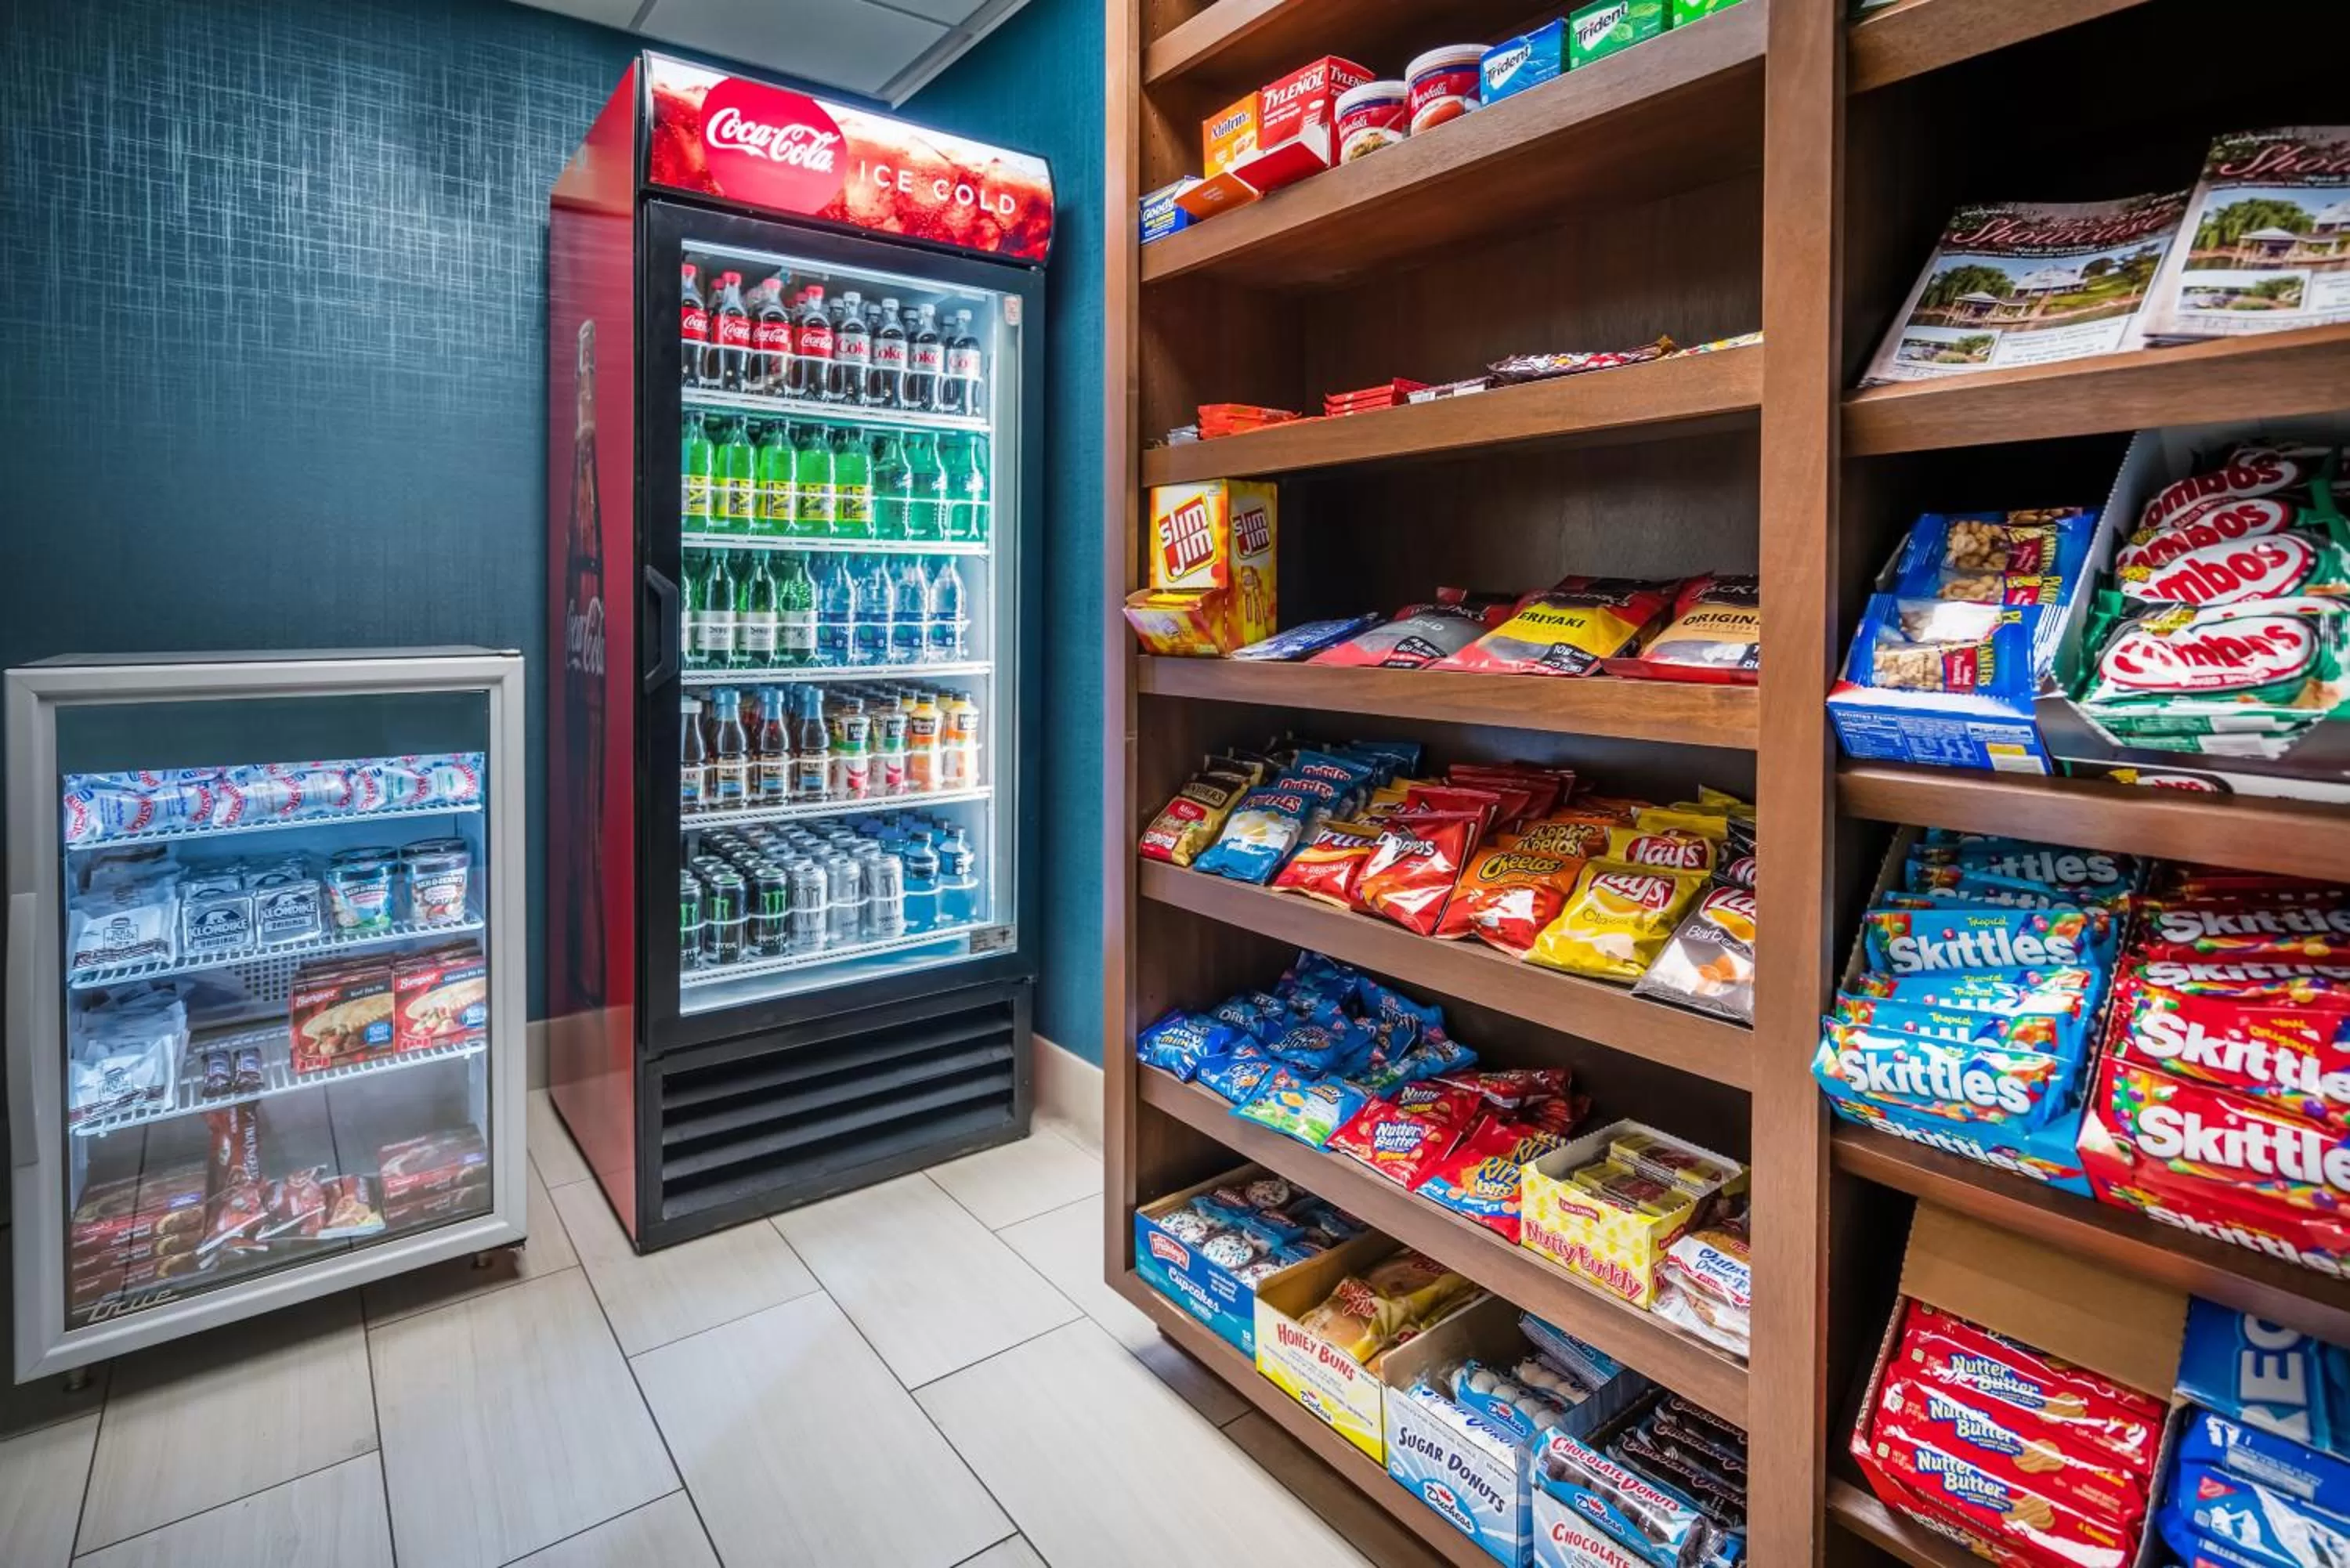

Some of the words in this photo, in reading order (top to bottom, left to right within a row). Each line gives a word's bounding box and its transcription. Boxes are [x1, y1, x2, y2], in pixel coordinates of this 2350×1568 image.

[1575, 0, 1627, 45] Trident
[1330, 66, 1366, 87] TYLEN
[1486, 45, 1530, 84] Trident
[1264, 69, 1325, 114] TYLENOL
[707, 107, 840, 173] Coca-Cola
[860, 161, 913, 193] ICE
[932, 179, 1016, 215] COLD
[1518, 612, 1586, 629] ERIYAKI
[1683, 613, 1759, 626] ORIGIN
[1889, 928, 2077, 974] Skittles
[1839, 1047, 2031, 1114] Skittles
[1525, 1220, 1578, 1265] Nutty
[1574, 1244, 1644, 1302] Buddy
[1277, 1322, 1317, 1355] HONEY
[1318, 1343, 1356, 1382] BUNS
[1950, 1353, 2011, 1377] Nutter
[1977, 1375, 2040, 1395] Butter
[1956, 1419, 2016, 1443] Butter
[1398, 1426, 1444, 1462] SUGAR
[1447, 1453, 1506, 1513] DONUTS
[1551, 1436, 1624, 1480] CHOCOLATE
[1618, 1476, 1680, 1512] DONUTS
[1916, 1449, 1973, 1475] Nutter
[1943, 1471, 2006, 1498] Butter
[1426, 1484, 1473, 1530] Duchess
[1574, 1493, 1625, 1535] Duchess
